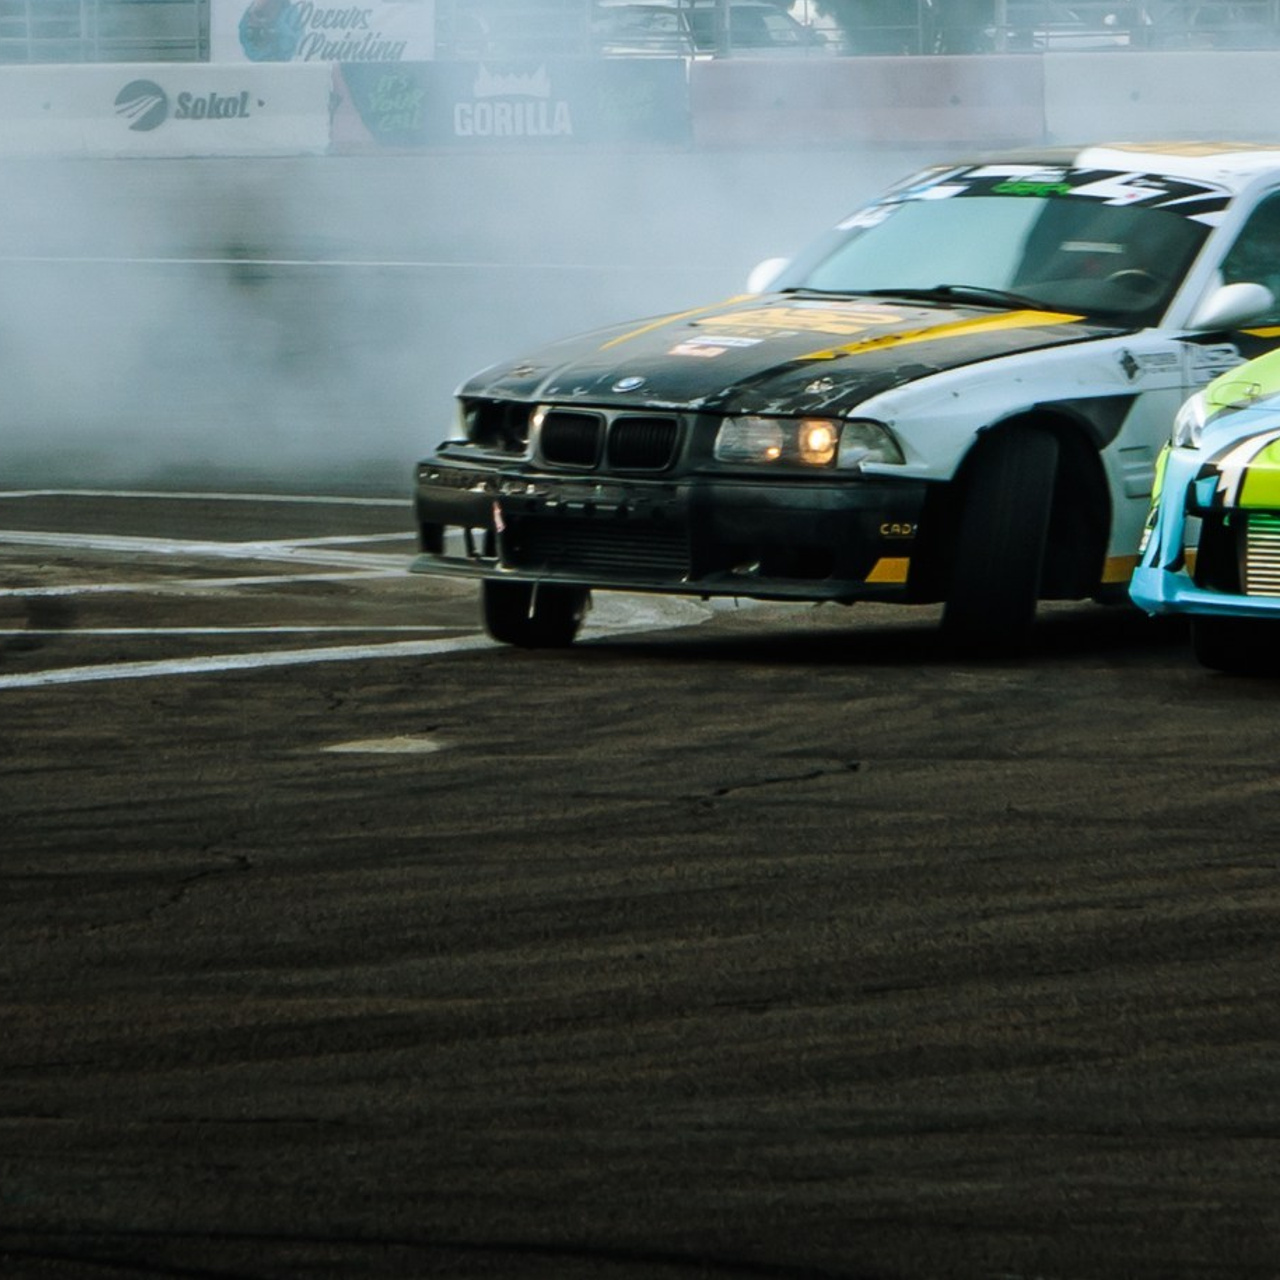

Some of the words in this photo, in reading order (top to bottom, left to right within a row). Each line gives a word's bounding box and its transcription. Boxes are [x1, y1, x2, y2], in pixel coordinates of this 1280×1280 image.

[175, 91, 250, 120] Sokol
[453, 101, 573, 136] GORILLA
[880, 523, 918, 536] CAD
